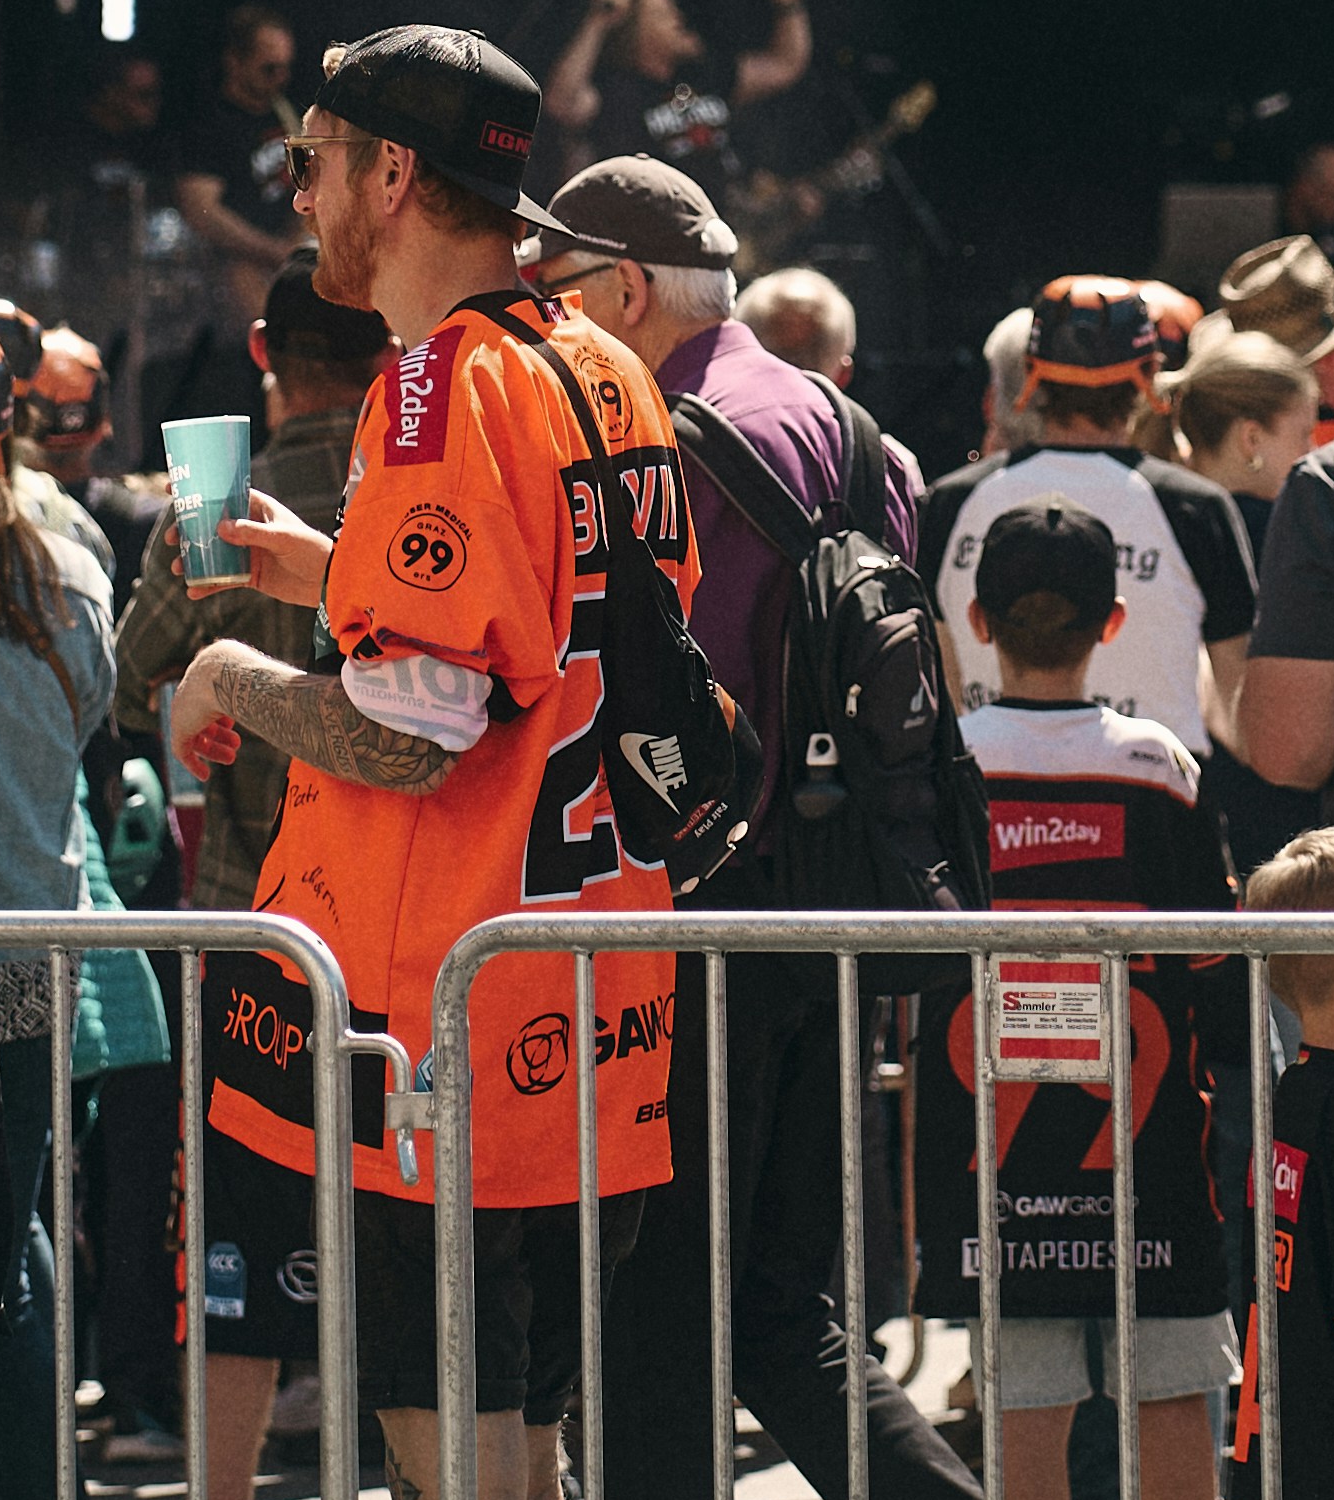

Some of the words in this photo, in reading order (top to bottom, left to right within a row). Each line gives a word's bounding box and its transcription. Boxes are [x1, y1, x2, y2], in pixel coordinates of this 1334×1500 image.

[417, 521, 447, 538] GRAZ
[435, 503, 474, 542] MEDICAL
[401, 532, 454, 576] 99
[413, 571, 432, 583] ers
[648, 735, 688, 794] NIKE
[710, 801, 729, 821] Fair
[693, 818, 715, 839] Play
[994, 816, 1102, 851] win2day
[1003, 991, 1057, 1012] Semmler
[1004, 1239, 1173, 1270] TAPEDESGN
